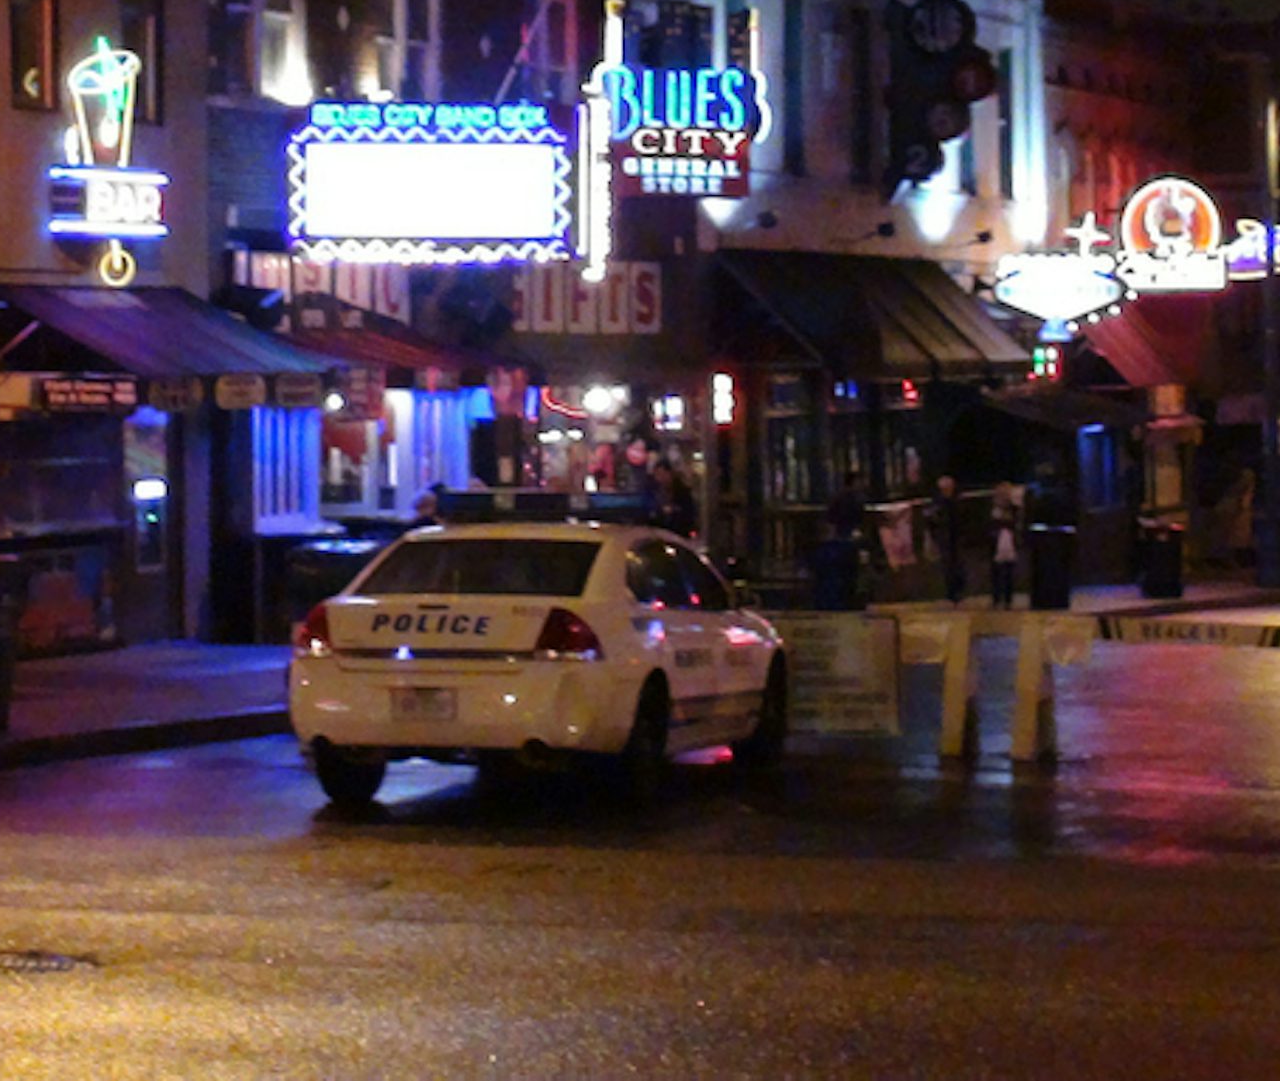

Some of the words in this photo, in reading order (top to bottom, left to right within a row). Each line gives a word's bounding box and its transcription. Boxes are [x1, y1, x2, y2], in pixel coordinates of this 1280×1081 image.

[604, 68, 744, 140] BLUES
[632, 129, 747, 156] CITY
[623, 158, 740, 177] GENERAL
[641, 177, 722, 194] STORE
[87, 180, 161, 222] BAR
[373, 613, 491, 636] POLICE
